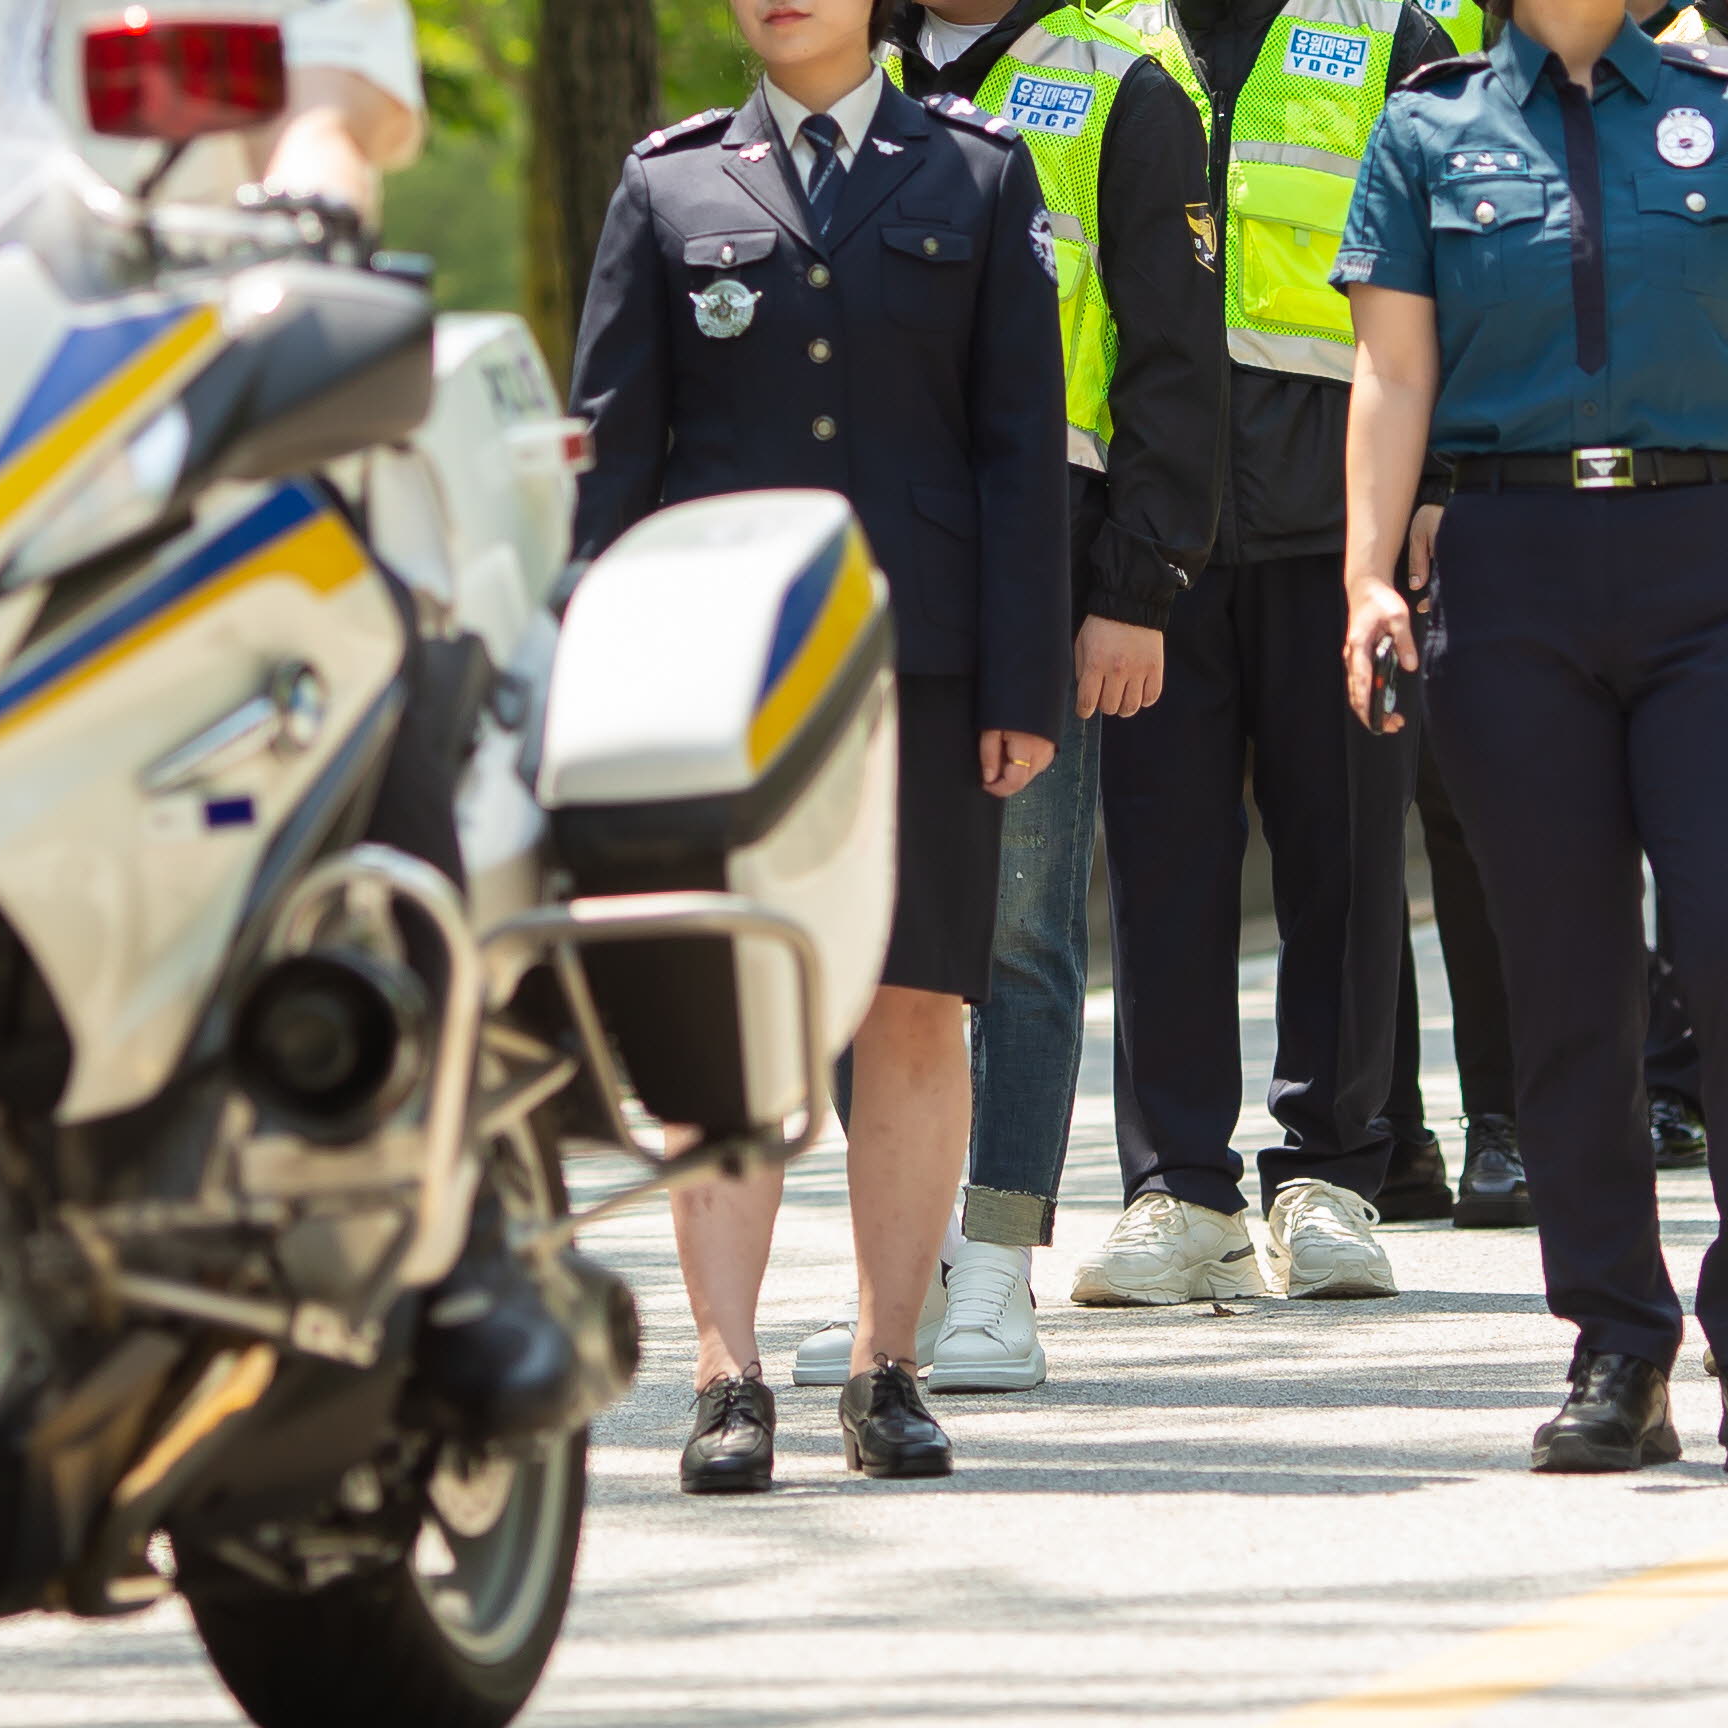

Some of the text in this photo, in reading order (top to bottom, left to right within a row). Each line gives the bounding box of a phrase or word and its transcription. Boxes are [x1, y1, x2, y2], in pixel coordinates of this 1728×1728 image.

[1295, 32, 1364, 62] 유원대학교
[1293, 55, 1356, 78] YDCP
[1015, 80, 1090, 112] 유원대학교
[1011, 106, 1077, 129] YDCP
